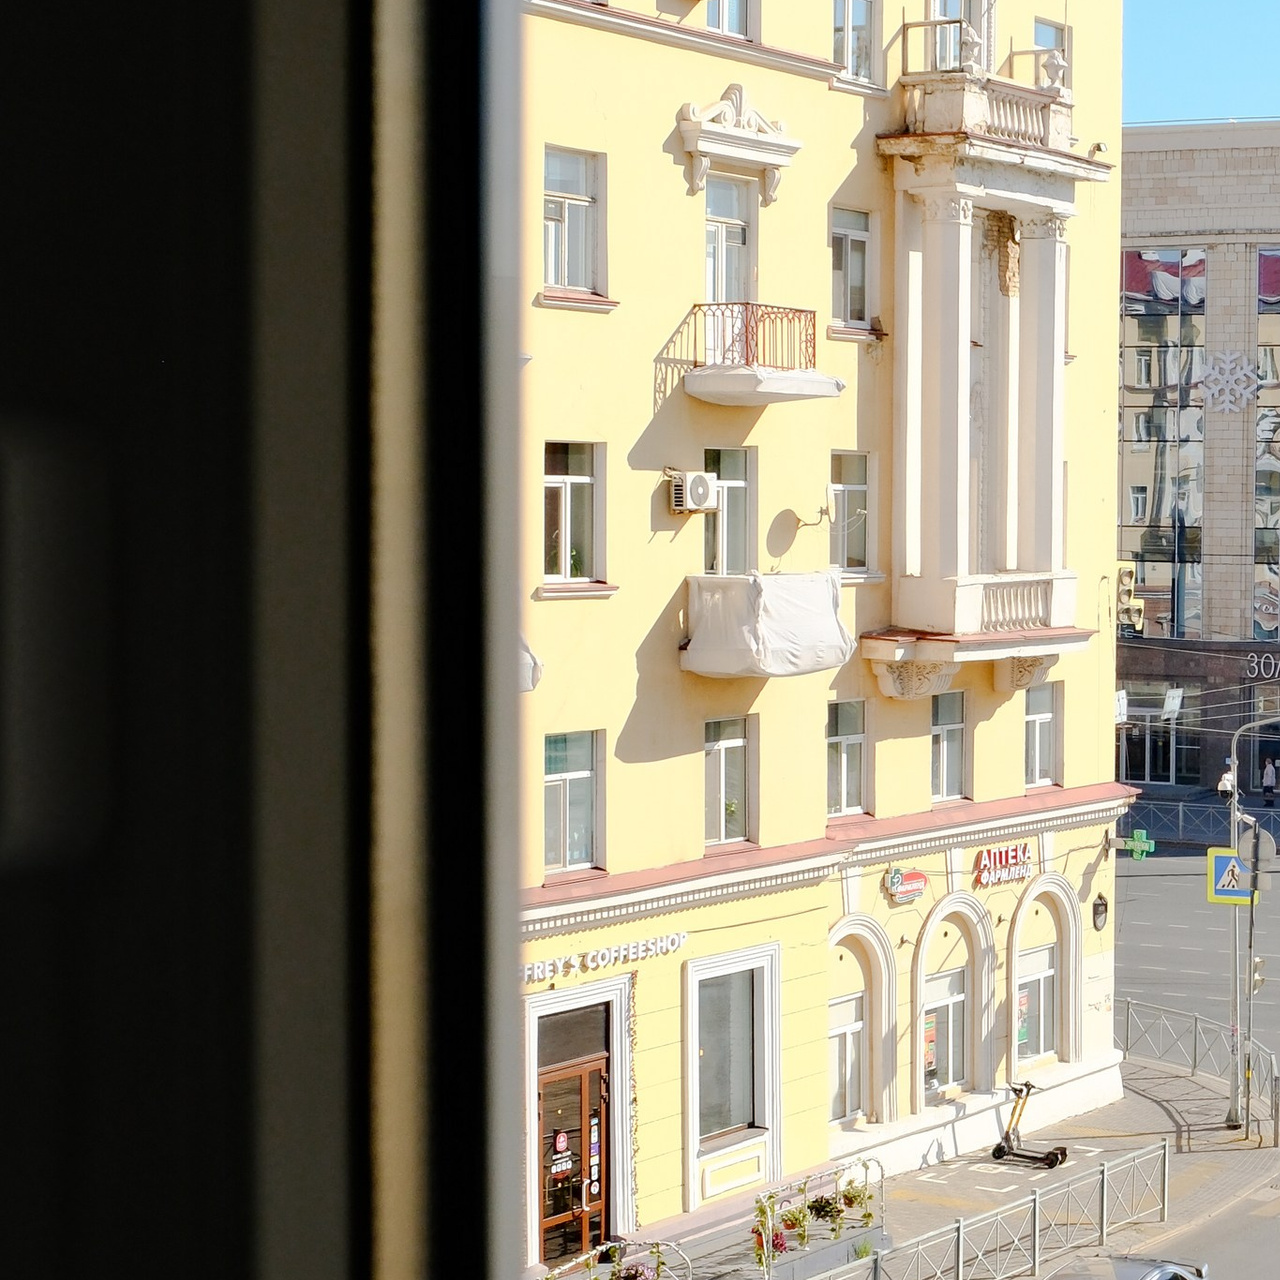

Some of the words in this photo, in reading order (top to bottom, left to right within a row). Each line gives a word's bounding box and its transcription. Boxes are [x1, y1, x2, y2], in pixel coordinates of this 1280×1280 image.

[979, 842, 1032, 870] АПТЕКА
[980, 864, 1032, 886] ФАРМЛЕНД
[586, 931, 688, 969] COFFEESHOP
